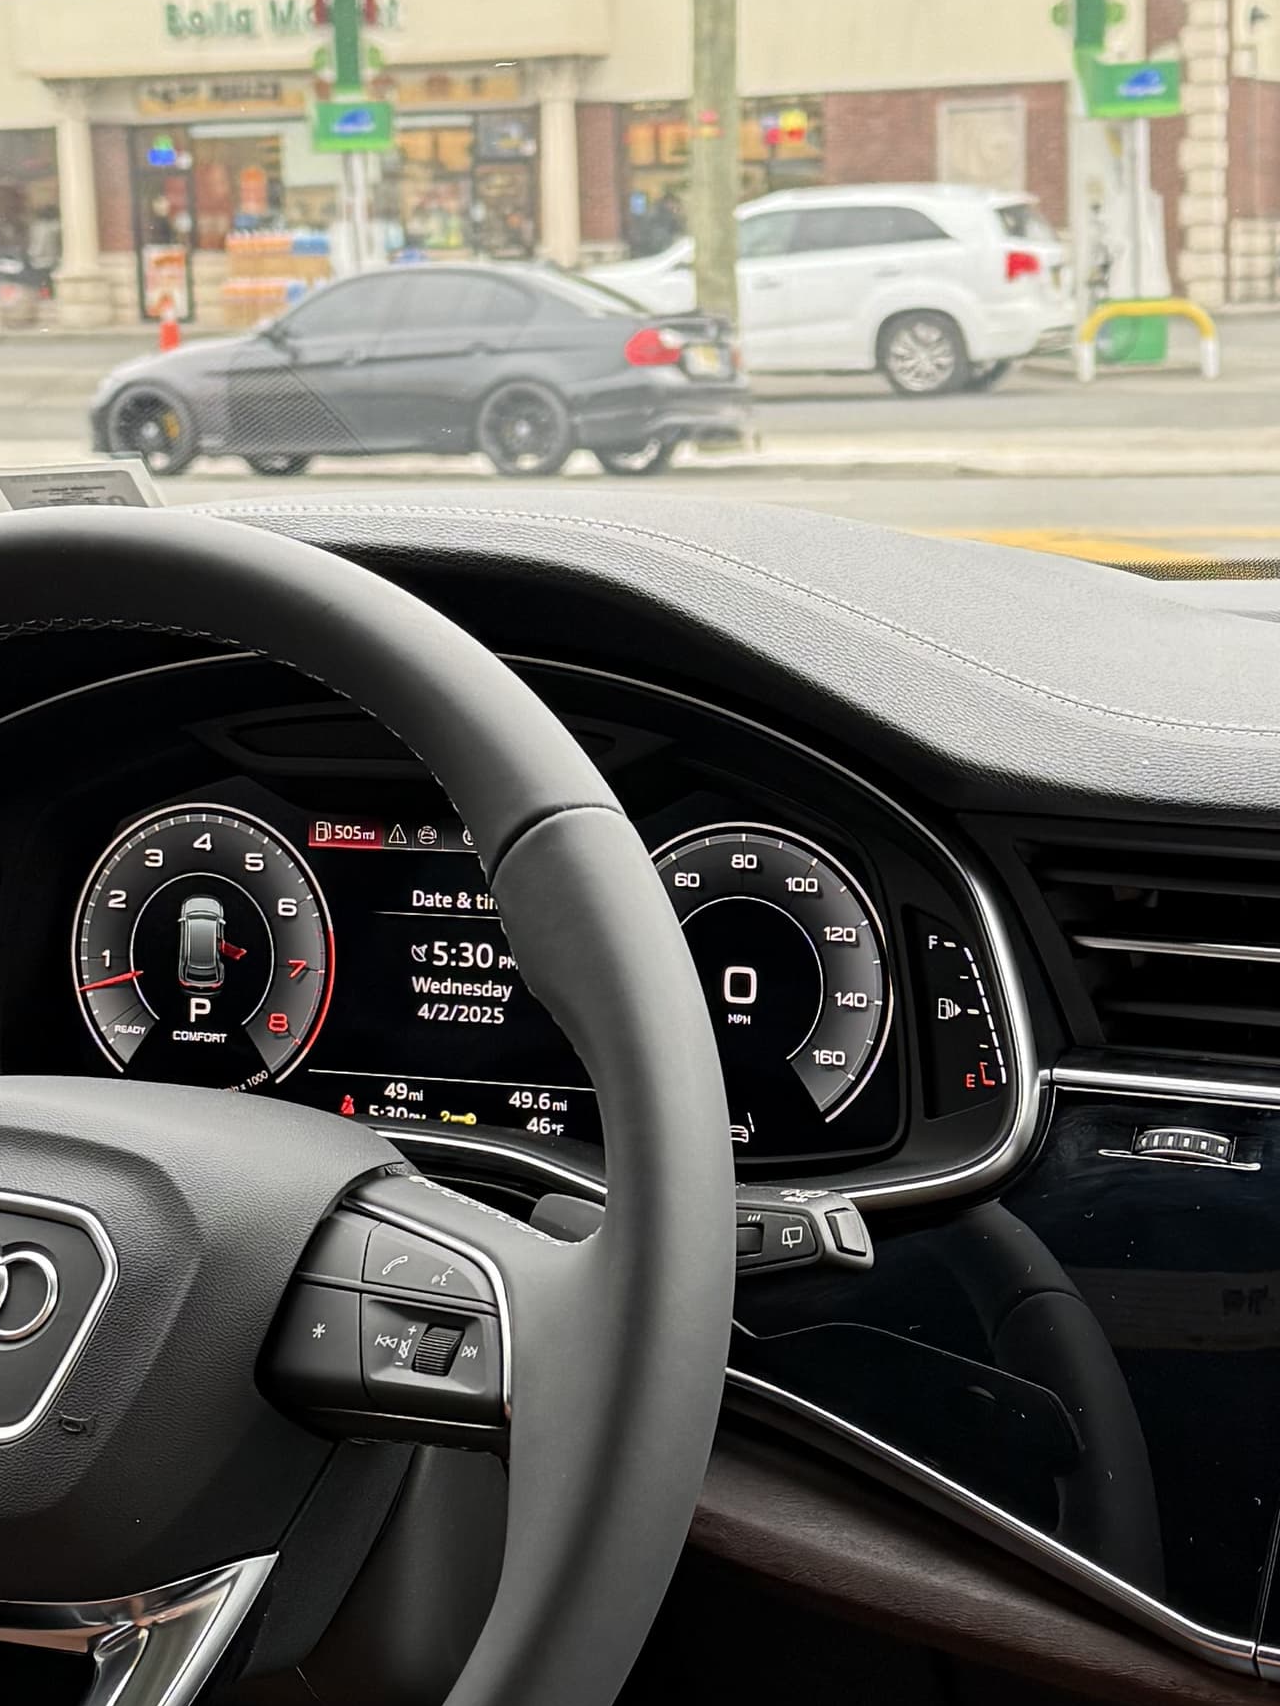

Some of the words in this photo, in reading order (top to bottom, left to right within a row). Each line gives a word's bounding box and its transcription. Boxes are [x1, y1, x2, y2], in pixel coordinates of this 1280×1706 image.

[194, 833, 211, 850] 4
[145, 849, 162, 866] 3
[246, 853, 263, 870] 5
[732, 854, 757, 868] 80
[675, 873, 699, 887] 60
[786, 878, 817, 892] 100
[109, 890, 126, 907] 2
[413, 890, 452, 907] Date
[457, 892, 471, 908] &
[278, 899, 297, 916] 6
[824, 927, 856, 942] 120
[929, 936, 937, 949] F
[103, 950, 109, 966] 1
[433, 942, 493, 968] 5:30
[289, 960, 306, 977] 7
[412, 977, 512, 1002] Wednesday
[724, 967, 756, 1004] 0
[835, 992, 867, 1007] 140
[191, 998, 210, 1022] P
[418, 1004, 504, 1023] 4/2/2025
[269, 1014, 288, 1031] 8
[728, 1014, 750, 1024] MPH
[114, 1024, 146, 1036] READY
[173, 1031, 227, 1042] COMFORT
[813, 1050, 845, 1065] 160
[967, 1074, 975, 1087] E
